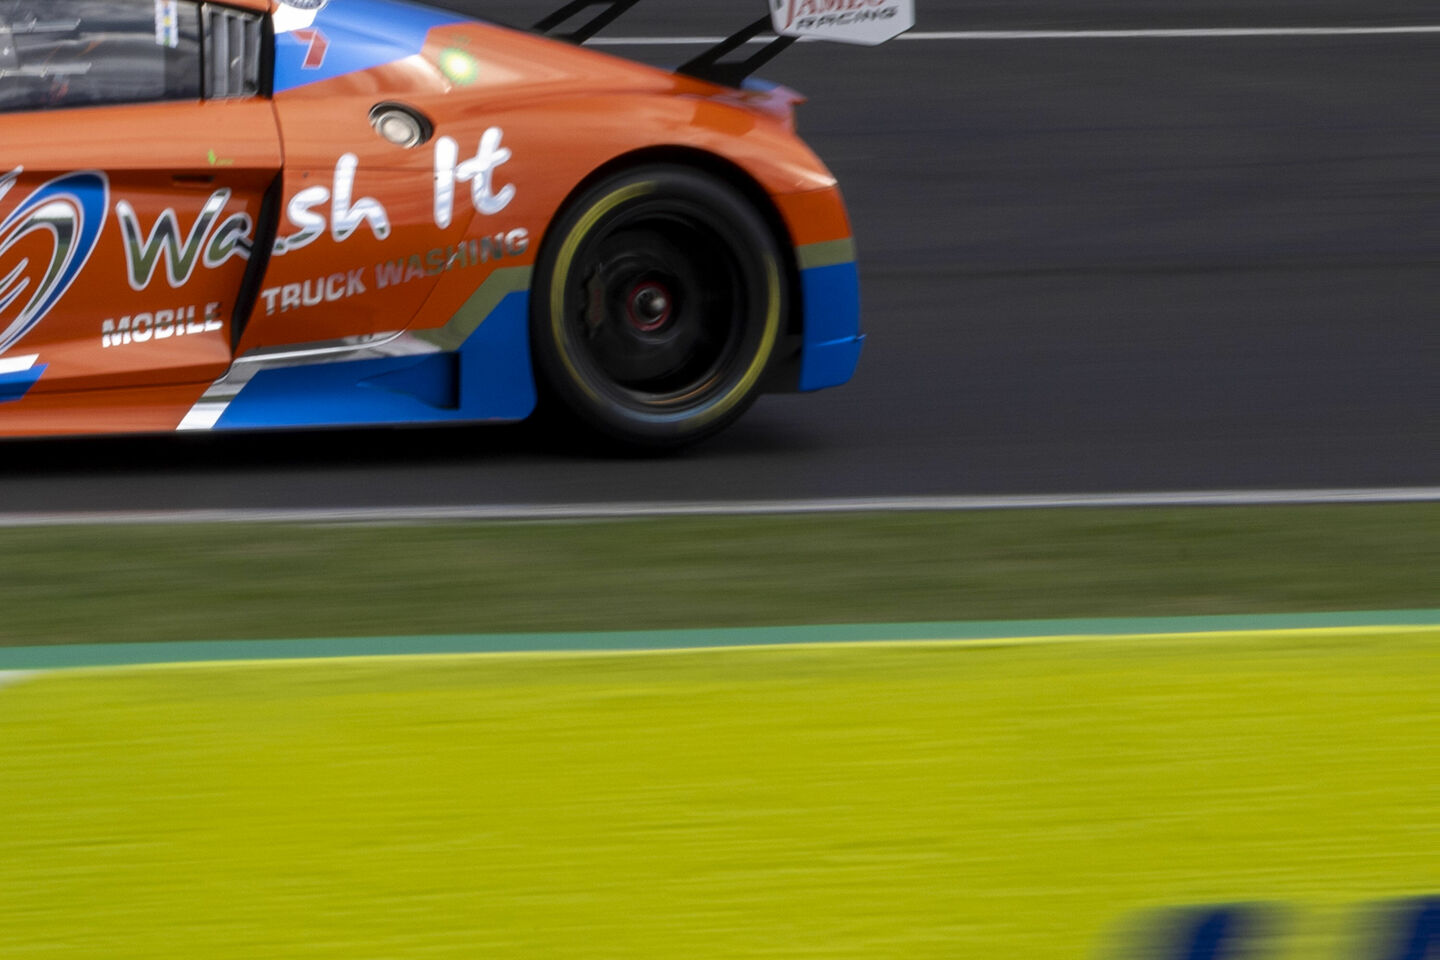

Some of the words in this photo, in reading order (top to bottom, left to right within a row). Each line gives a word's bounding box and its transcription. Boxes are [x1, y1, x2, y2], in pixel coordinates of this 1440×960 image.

[796, 6, 898, 30] RACING
[115, 152, 391, 292] Wash
[432, 125, 516, 230] It
[260, 266, 366, 316] TRUCK
[374, 226, 530, 290] WASHING
[101, 301, 223, 348] MOBILE
